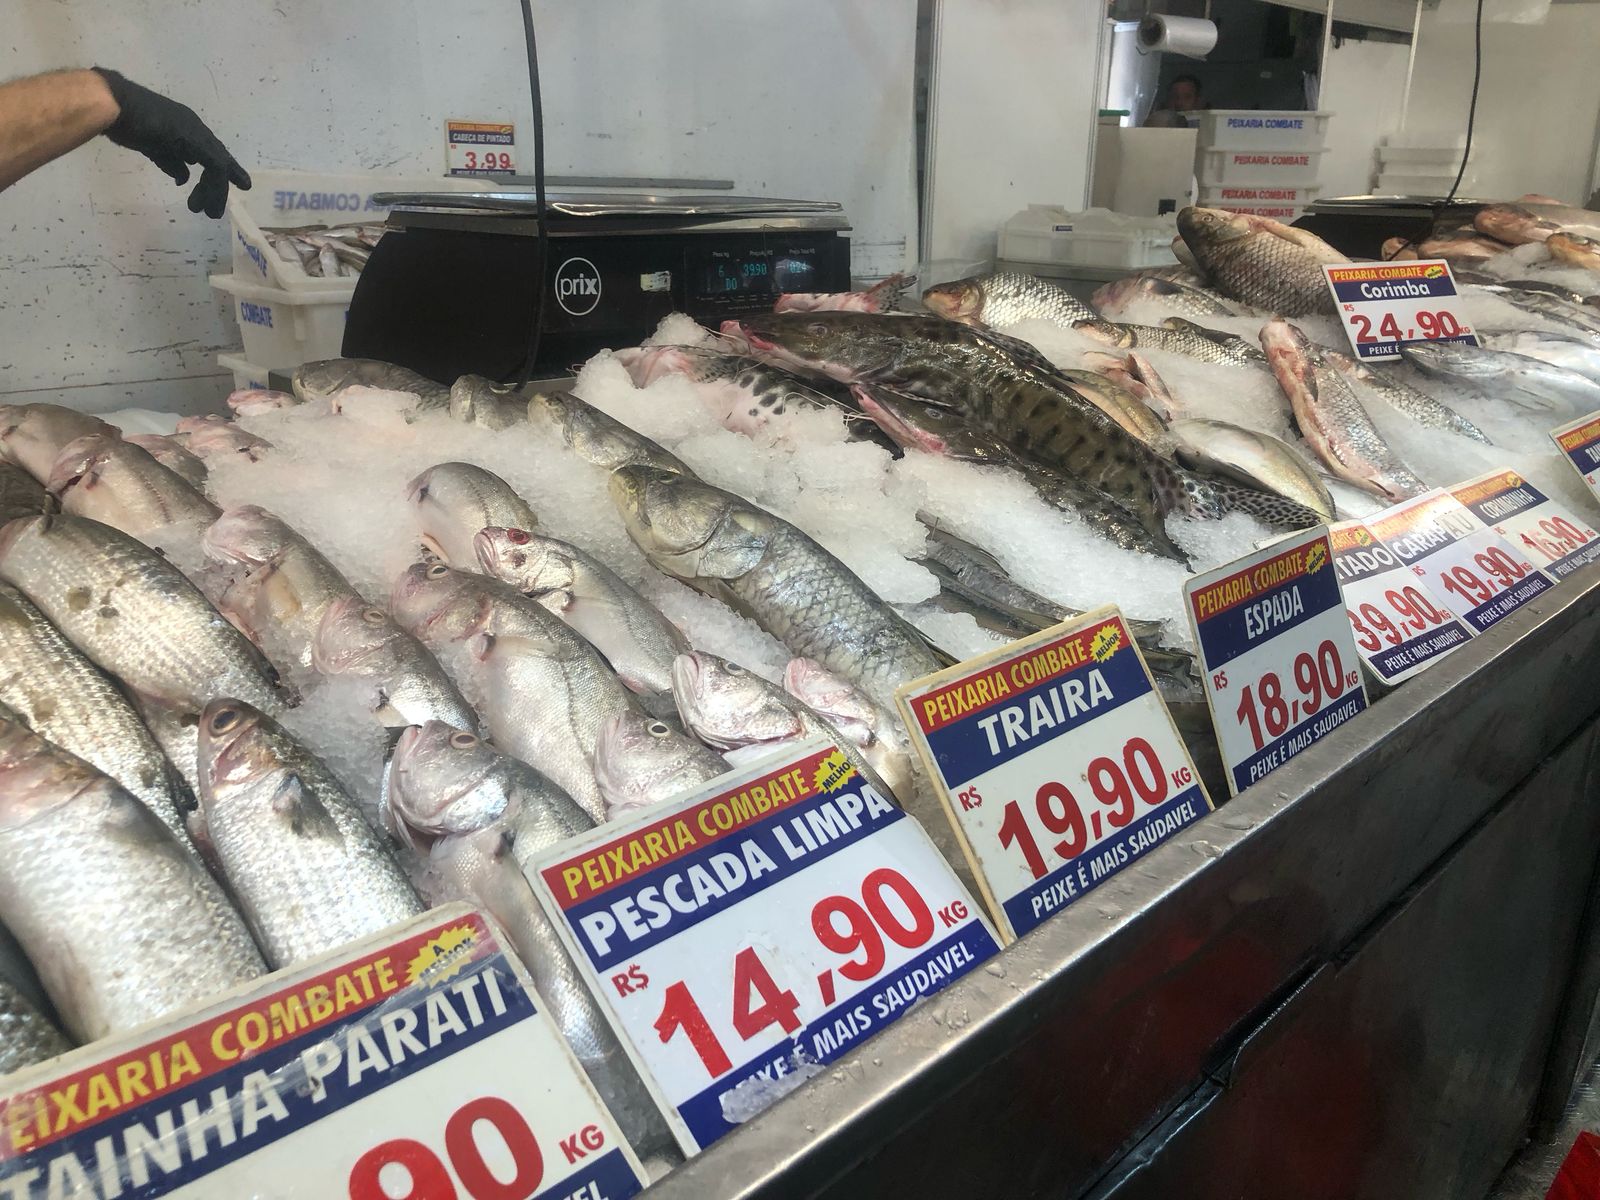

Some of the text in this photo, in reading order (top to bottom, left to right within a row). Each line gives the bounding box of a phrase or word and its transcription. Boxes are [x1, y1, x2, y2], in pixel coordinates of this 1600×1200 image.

[1228, 118, 1304, 129] PEIXARIA COMBATE
[464, 151, 511, 170] 3,99
[1233, 155, 1310, 166] PEIXARIA COMBATE
[1221, 189, 1297, 201] PEIXARIA COMBATE
[560, 273, 598, 300] prix
[1334, 269, 1377, 281] PEIXARIA
[1379, 267, 1422, 279] COMBATE
[1360, 279, 1431, 299] Corimba
[1350, 311, 1461, 344] 24,90
[1369, 345, 1393, 355] PEIXE
[1335, 546, 1395, 581] TADO
[1439, 545, 1526, 608] 19,90
[1197, 552, 1304, 618] PEIXARIA COMBATE
[1244, 584, 1305, 640] ESPADA
[1346, 585, 1443, 652] 39,90
[1476, 607, 1500, 626] PEIXE
[1094, 632, 1120, 662] MELHOR
[1384, 652, 1411, 672] PEIXE
[1411, 642, 1434, 660] MAIS
[922, 638, 1088, 728] PEIXARIA COMBATE
[1236, 638, 1345, 752] 18,90
[1345, 669, 1359, 690] KG
[977, 668, 1115, 757] TRAIRA
[827, 760, 837, 771] A
[1249, 751, 1280, 783] PEIXE
[1279, 740, 1288, 763] É
[1287, 731, 1313, 759] MAIS
[1170, 766, 1192, 790] KG
[997, 736, 1169, 881] 19,90
[562, 767, 811, 900] PEIXARIA COMBATE
[578, 783, 895, 958] PESCADA LIMPA
[1030, 875, 1076, 919] PEIXE
[1077, 861, 1090, 889] É
[1092, 846, 1129, 882] MAIS
[937, 900, 969, 931] KG
[432, 944, 445, 957] A
[652, 867, 936, 1080] 14,90
[812, 1005, 873, 1060] MAIS
[7, 956, 399, 1150] EIXARIA COMBATE
[0, 966, 509, 1200] TAINHA PARATI
[558, 1124, 606, 1166] KG
